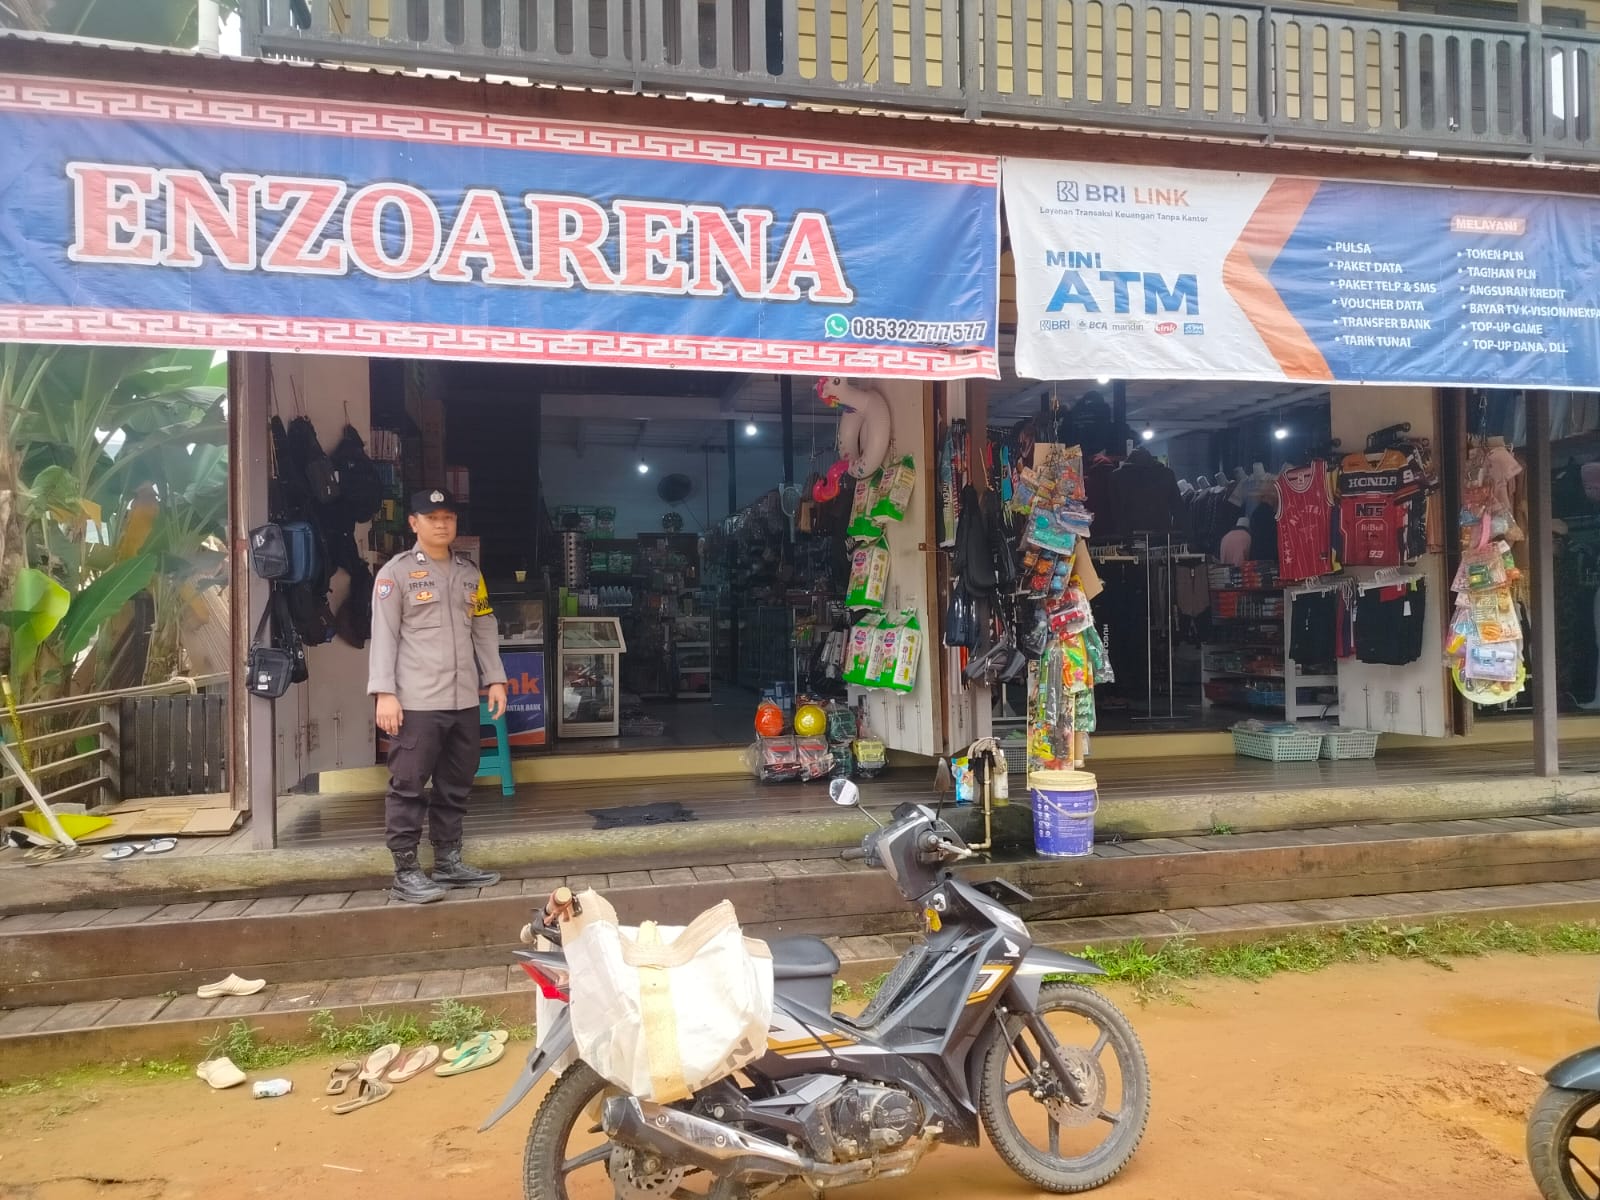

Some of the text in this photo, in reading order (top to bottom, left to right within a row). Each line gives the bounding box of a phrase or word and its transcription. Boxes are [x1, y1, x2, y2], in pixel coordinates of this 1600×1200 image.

[1085, 183, 1190, 207] BRI LINK
[1039, 206, 1208, 223] Layanan Transaksi Keuangan Tanpa Kantor
[1455, 217, 1518, 232] MELAYANI
[66, 161, 854, 303] ENZOARENA
[1335, 241, 1371, 254] PULSA
[1466, 248, 1524, 261] TOKEN PLN
[1045, 249, 1101, 269] MINI
[1337, 260, 1403, 274] PAKET DATA
[1467, 266, 1536, 280] TAGIHAN PLN
[1045, 269, 1200, 316] ATM
[1338, 279, 1437, 294] PAKET TELP & SMS
[1469, 285, 1566, 300] ANGSURAN KREDIT
[1340, 297, 1424, 312] VOUCHER DATA
[1469, 303, 1505, 315] BAYAR
[1506, 304, 1520, 316] TV
[851, 316, 987, 344] 085322777577
[1051, 319, 1070, 330] BRI
[1089, 321, 1108, 330] BCA
[1341, 316, 1431, 330] TRANSFER BANK
[1471, 321, 1543, 335] TOP-UP GAME
[1343, 335, 1411, 348] TARIK TUNAI
[1472, 339, 1568, 353] TOP-UP DANA, DLL
[1348, 476, 1397, 489] HONDA
[408, 581, 435, 590] IRFAN
